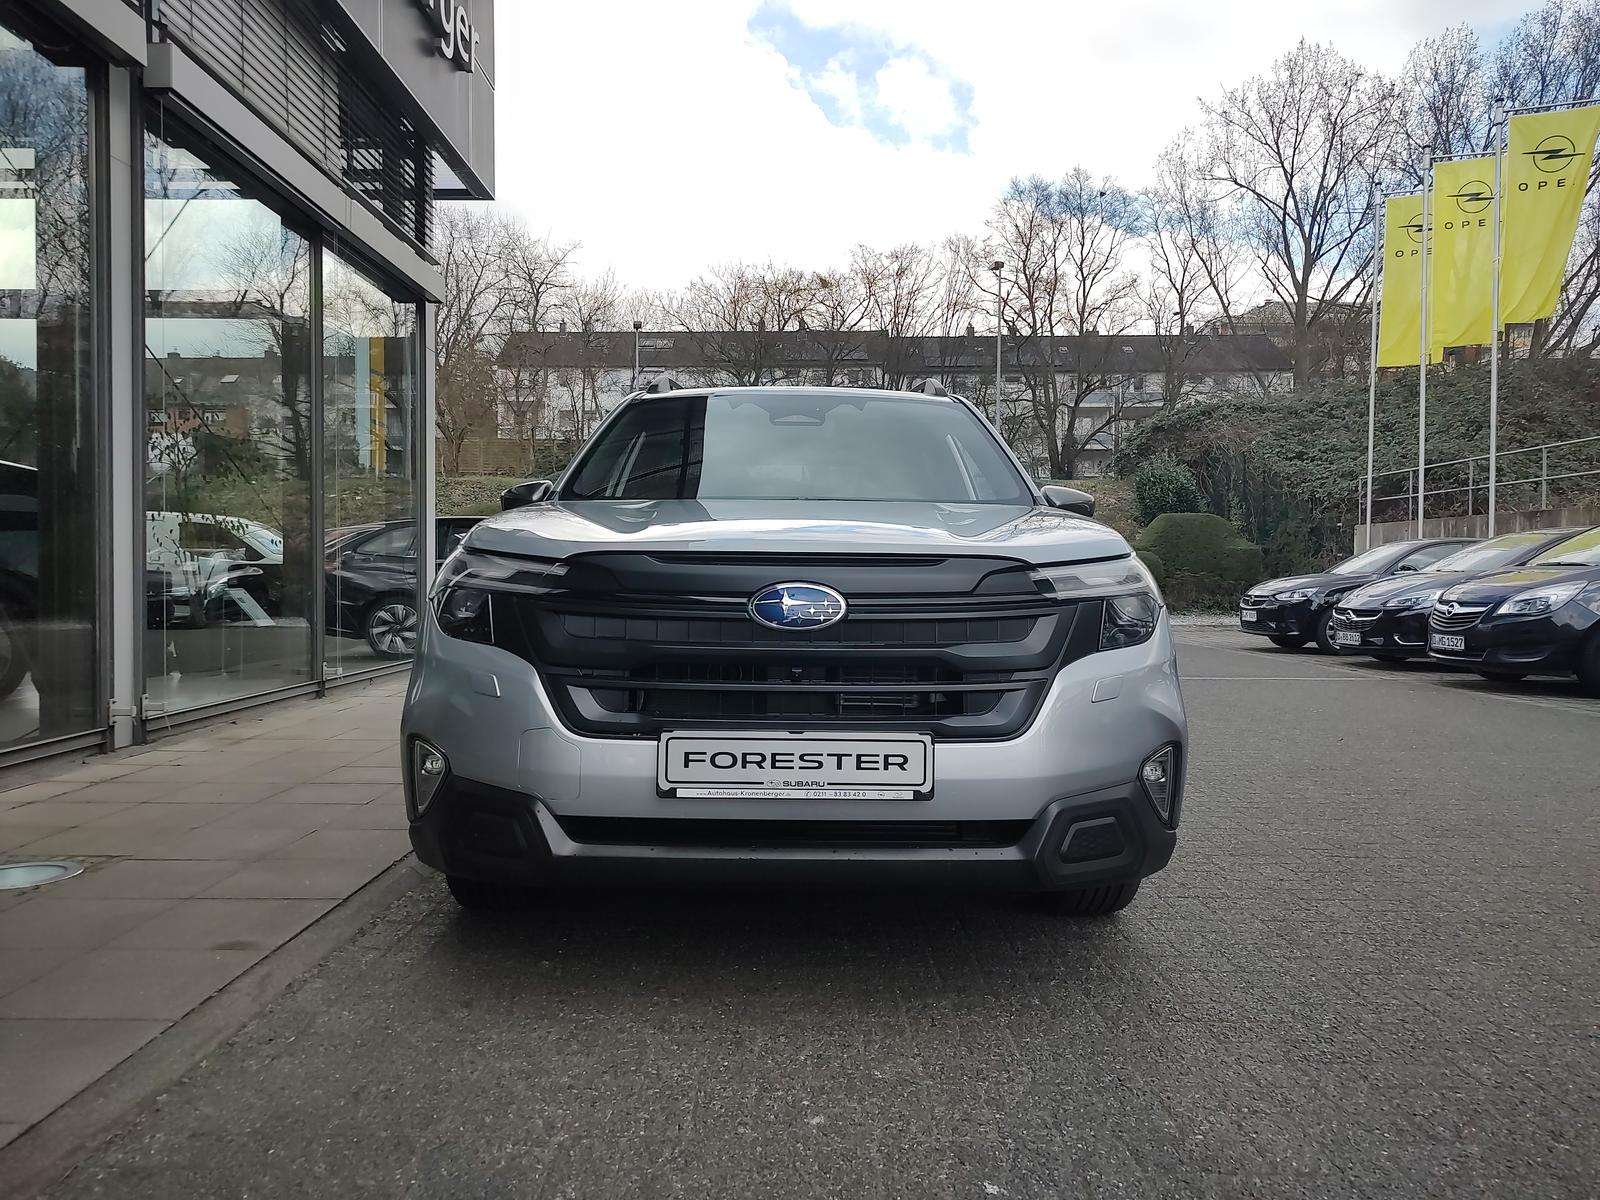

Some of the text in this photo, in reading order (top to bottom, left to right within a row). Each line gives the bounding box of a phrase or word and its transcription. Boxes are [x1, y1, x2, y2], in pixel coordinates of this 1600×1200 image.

[427, 0, 480, 73] ger
[1518, 178, 1576, 192] OPE
[1444, 218, 1503, 230] OPE
[1395, 247, 1433, 258] OPE
[683, 751, 909, 772] FORESTER
[782, 780, 826, 788] SUBARU
[696, 790, 791, 798] Autohaus-Kronenberger
